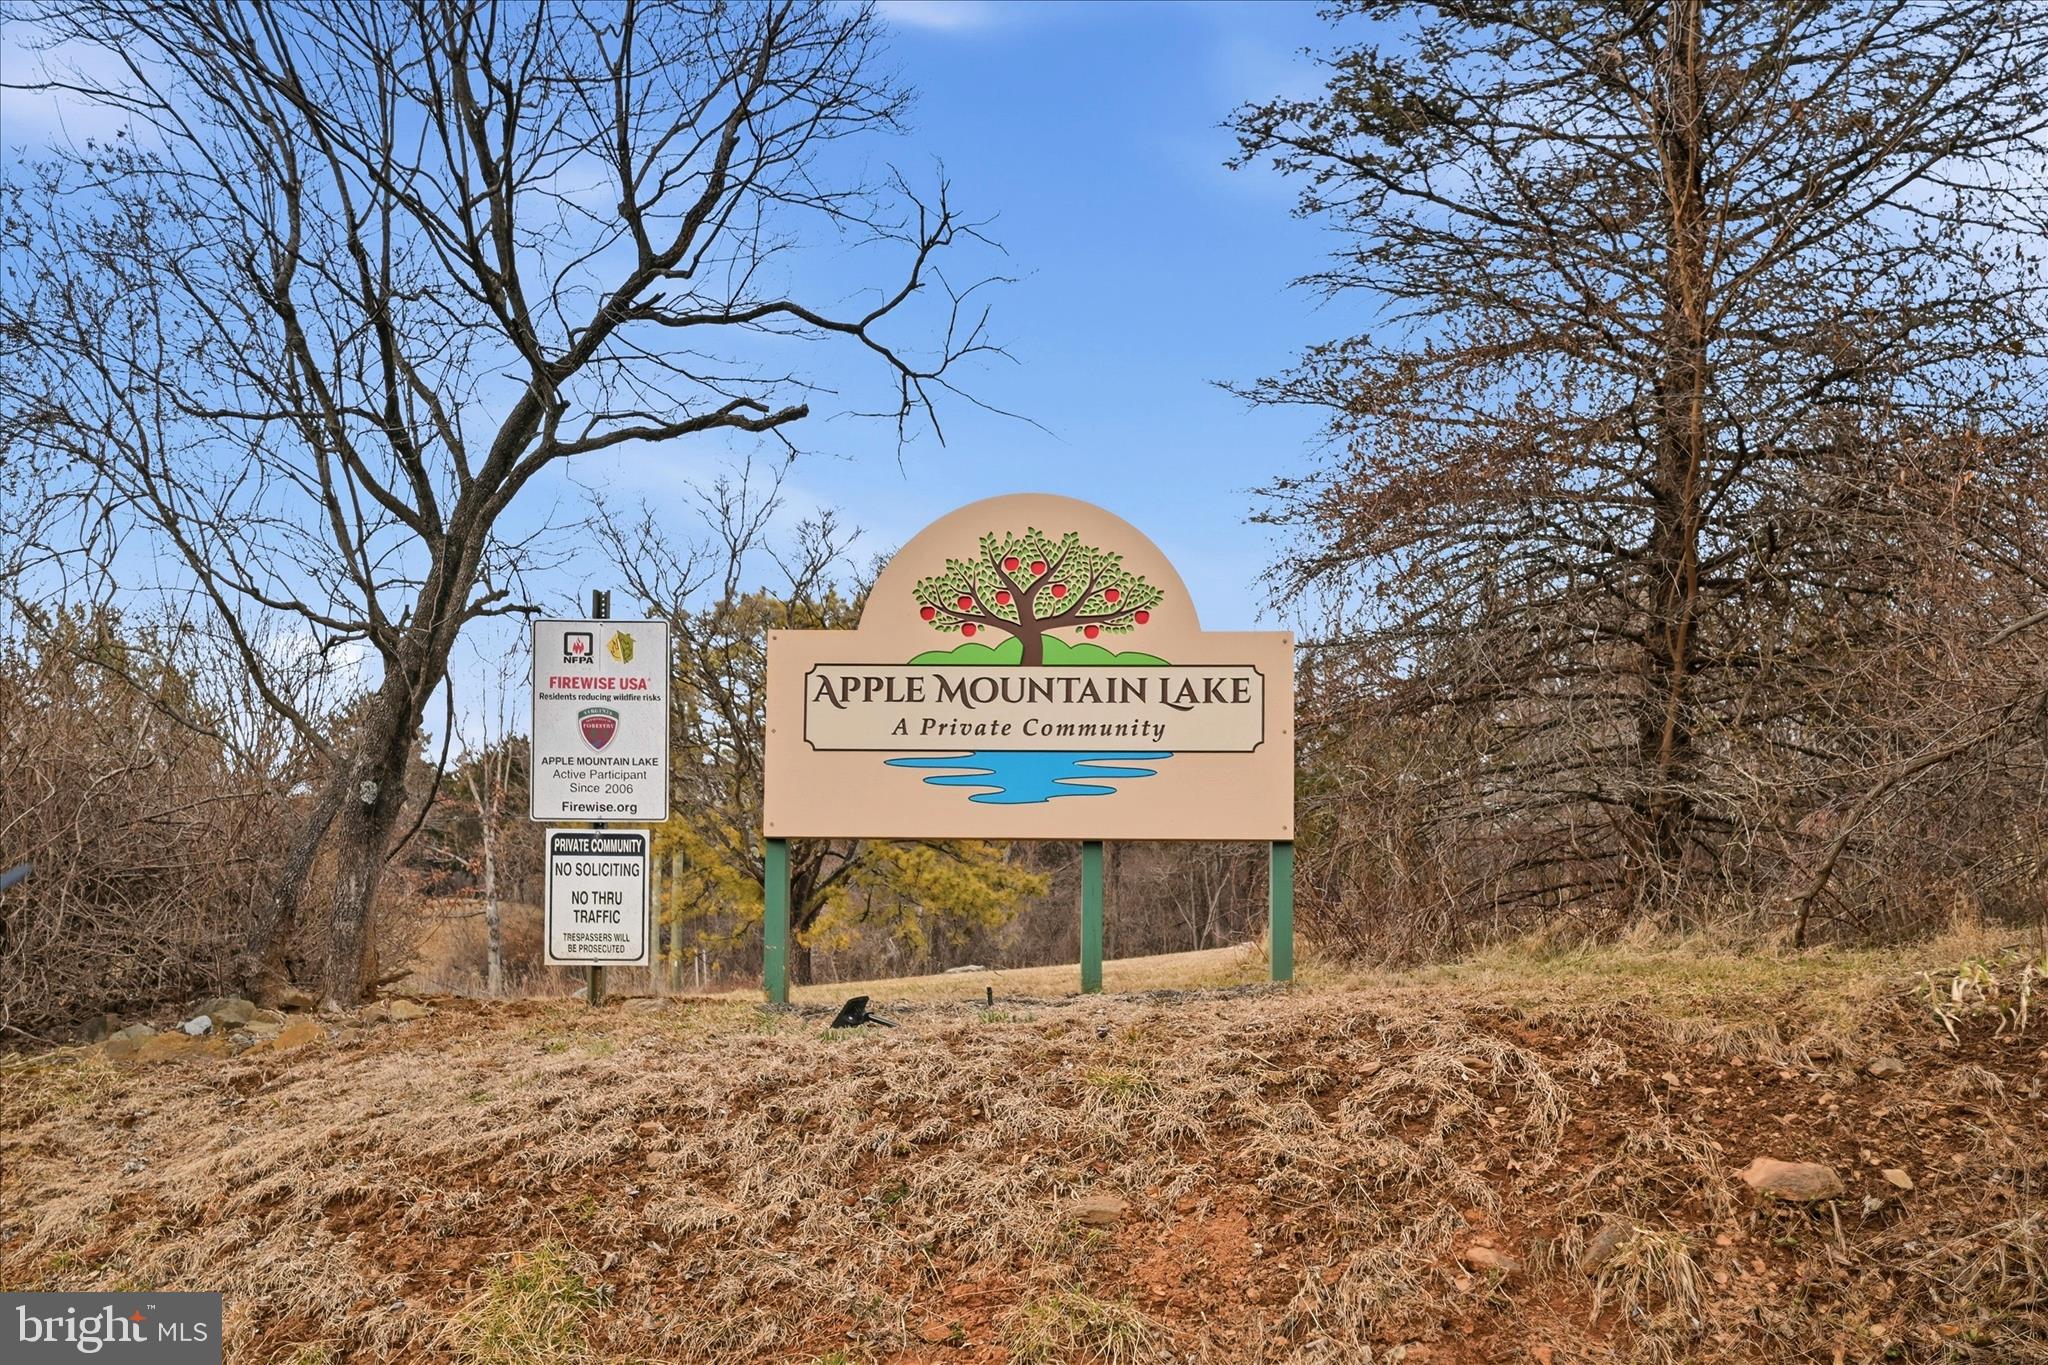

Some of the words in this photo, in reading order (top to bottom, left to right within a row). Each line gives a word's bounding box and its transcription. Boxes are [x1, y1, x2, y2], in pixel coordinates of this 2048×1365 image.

[564, 656, 593, 664] NFPA
[549, 677, 615, 689] FIREWISE
[539, 693, 576, 701] Residents
[812, 674, 925, 709] APPLE
[933, 674, 1146, 709] MOUNTAIN
[1158, 677, 1251, 711] LAKE
[891, 718, 909, 736] A
[920, 718, 1012, 737] Private
[1023, 719, 1166, 742] Community
[542, 757, 574, 765] APPLE
[577, 757, 630, 766] MOUNTAIN
[632, 758, 658, 766] LAKE
[553, 770, 586, 779] Active
[590, 770, 646, 781] Participant
[570, 783, 600, 793] Since
[605, 784, 633, 794] 2006
[562, 801, 637, 814] Firewise.org
[554, 838, 589, 852] PRIVATE
[591, 839, 642, 852] COMMUNITY
[555, 863, 572, 876] NO
[576, 863, 639, 877] SOLICITING
[572, 891, 588, 904] NO
[592, 892, 622, 905] THRU
[574, 910, 620, 923] TRAFFIC
[563, 933, 612, 942] TRESPASSERS
[614, 934, 630, 942] WILL
[568, 944, 576, 952] BE
[579, 945, 625, 953] PROSECUTED
